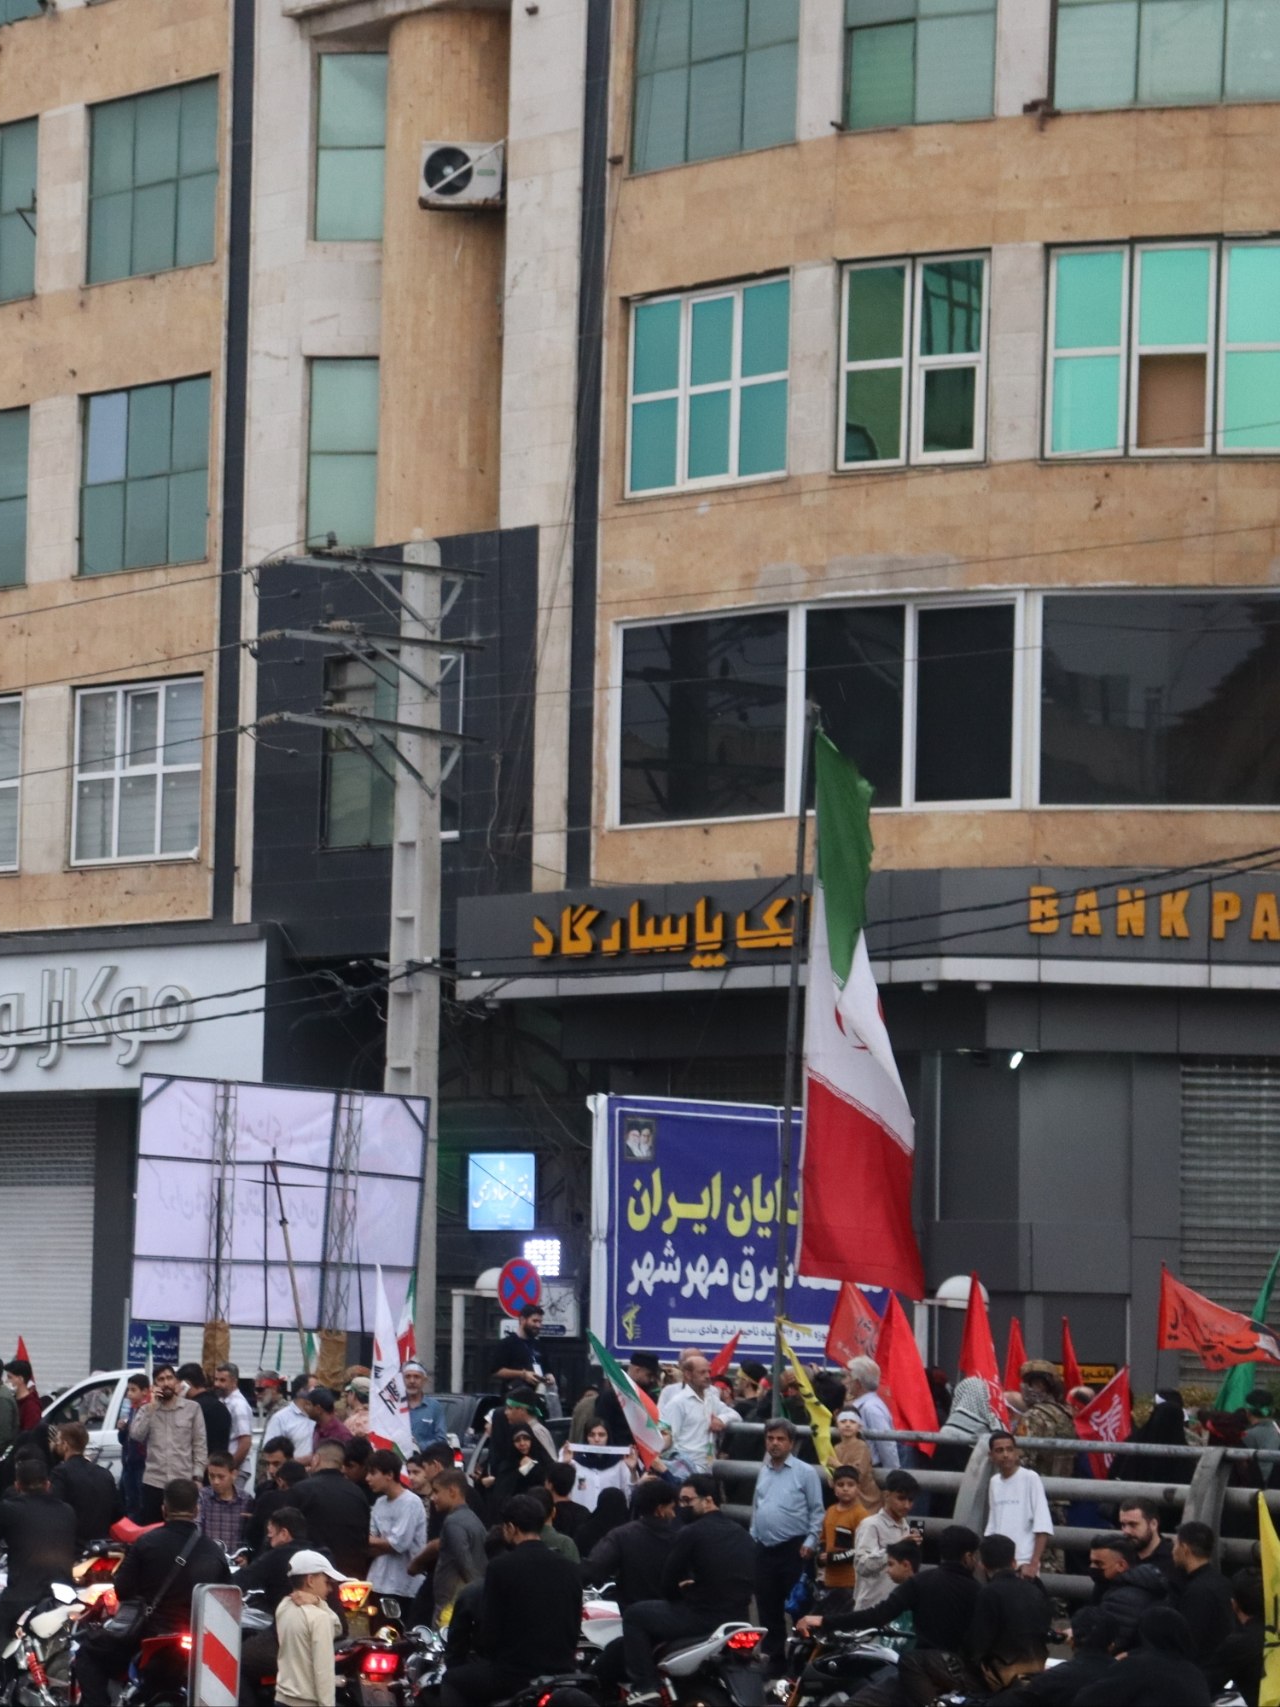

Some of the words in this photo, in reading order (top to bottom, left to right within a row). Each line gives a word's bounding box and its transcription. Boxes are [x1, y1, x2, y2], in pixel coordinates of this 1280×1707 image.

[532, 896, 726, 968] پاسارگاد
[1029, 885, 1191, 938] BANK
[627, 1167, 721, 1235] ایران
